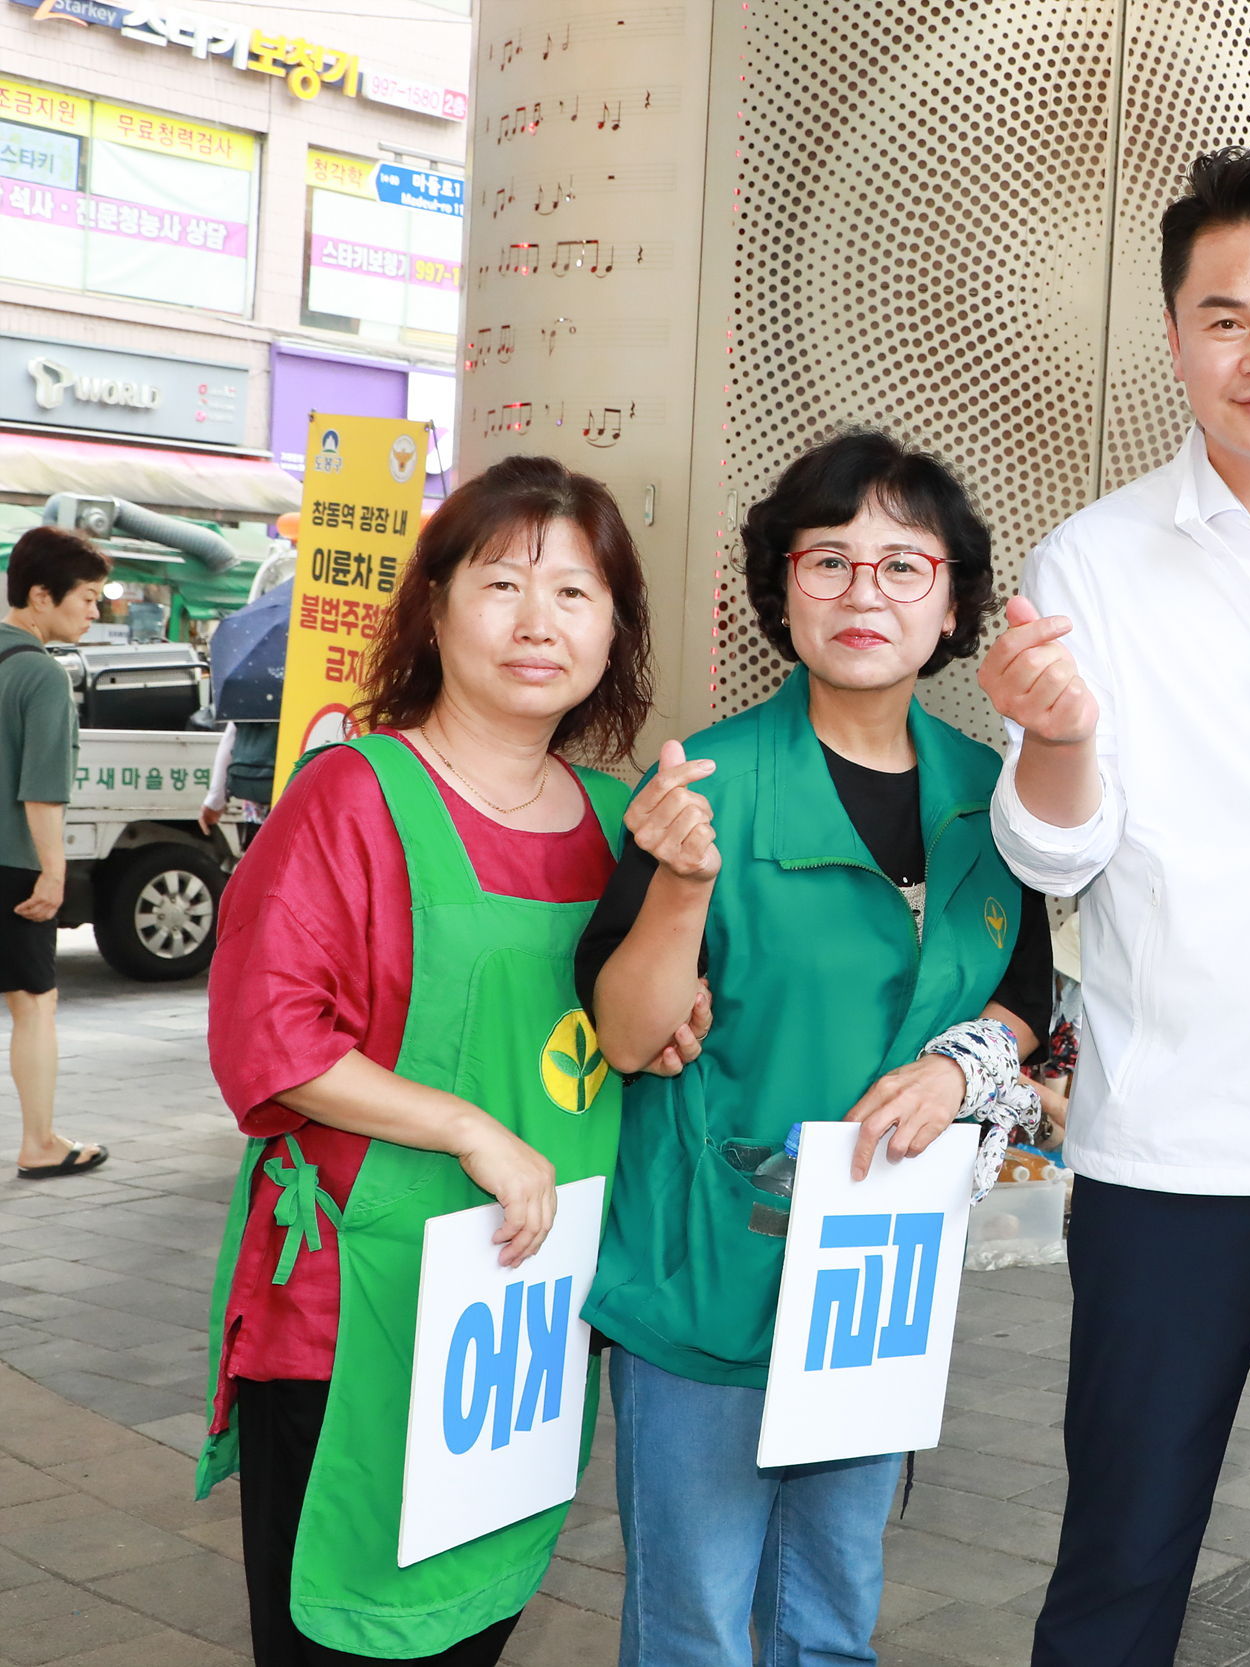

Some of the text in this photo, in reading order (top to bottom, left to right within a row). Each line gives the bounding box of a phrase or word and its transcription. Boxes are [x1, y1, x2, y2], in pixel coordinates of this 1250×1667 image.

[54, 0, 117, 23] Starkey
[121, 0, 360, 100] 스타키보청기
[370, 76, 441, 110] 997-1580
[117, 113, 233, 160] 무료청력검사
[0, 143, 55, 175] 스타키
[9, 183, 229, 251] 석사 전문청능사 상담
[73, 376, 163, 410] WORLD
[314, 455, 344, 474] 도봉구
[312, 500, 408, 537] 창동역 광장 내
[311, 547, 398, 593] 이륜차 등
[325, 645, 366, 687] 금지
[75, 767, 210, 791] 구새마을방역
